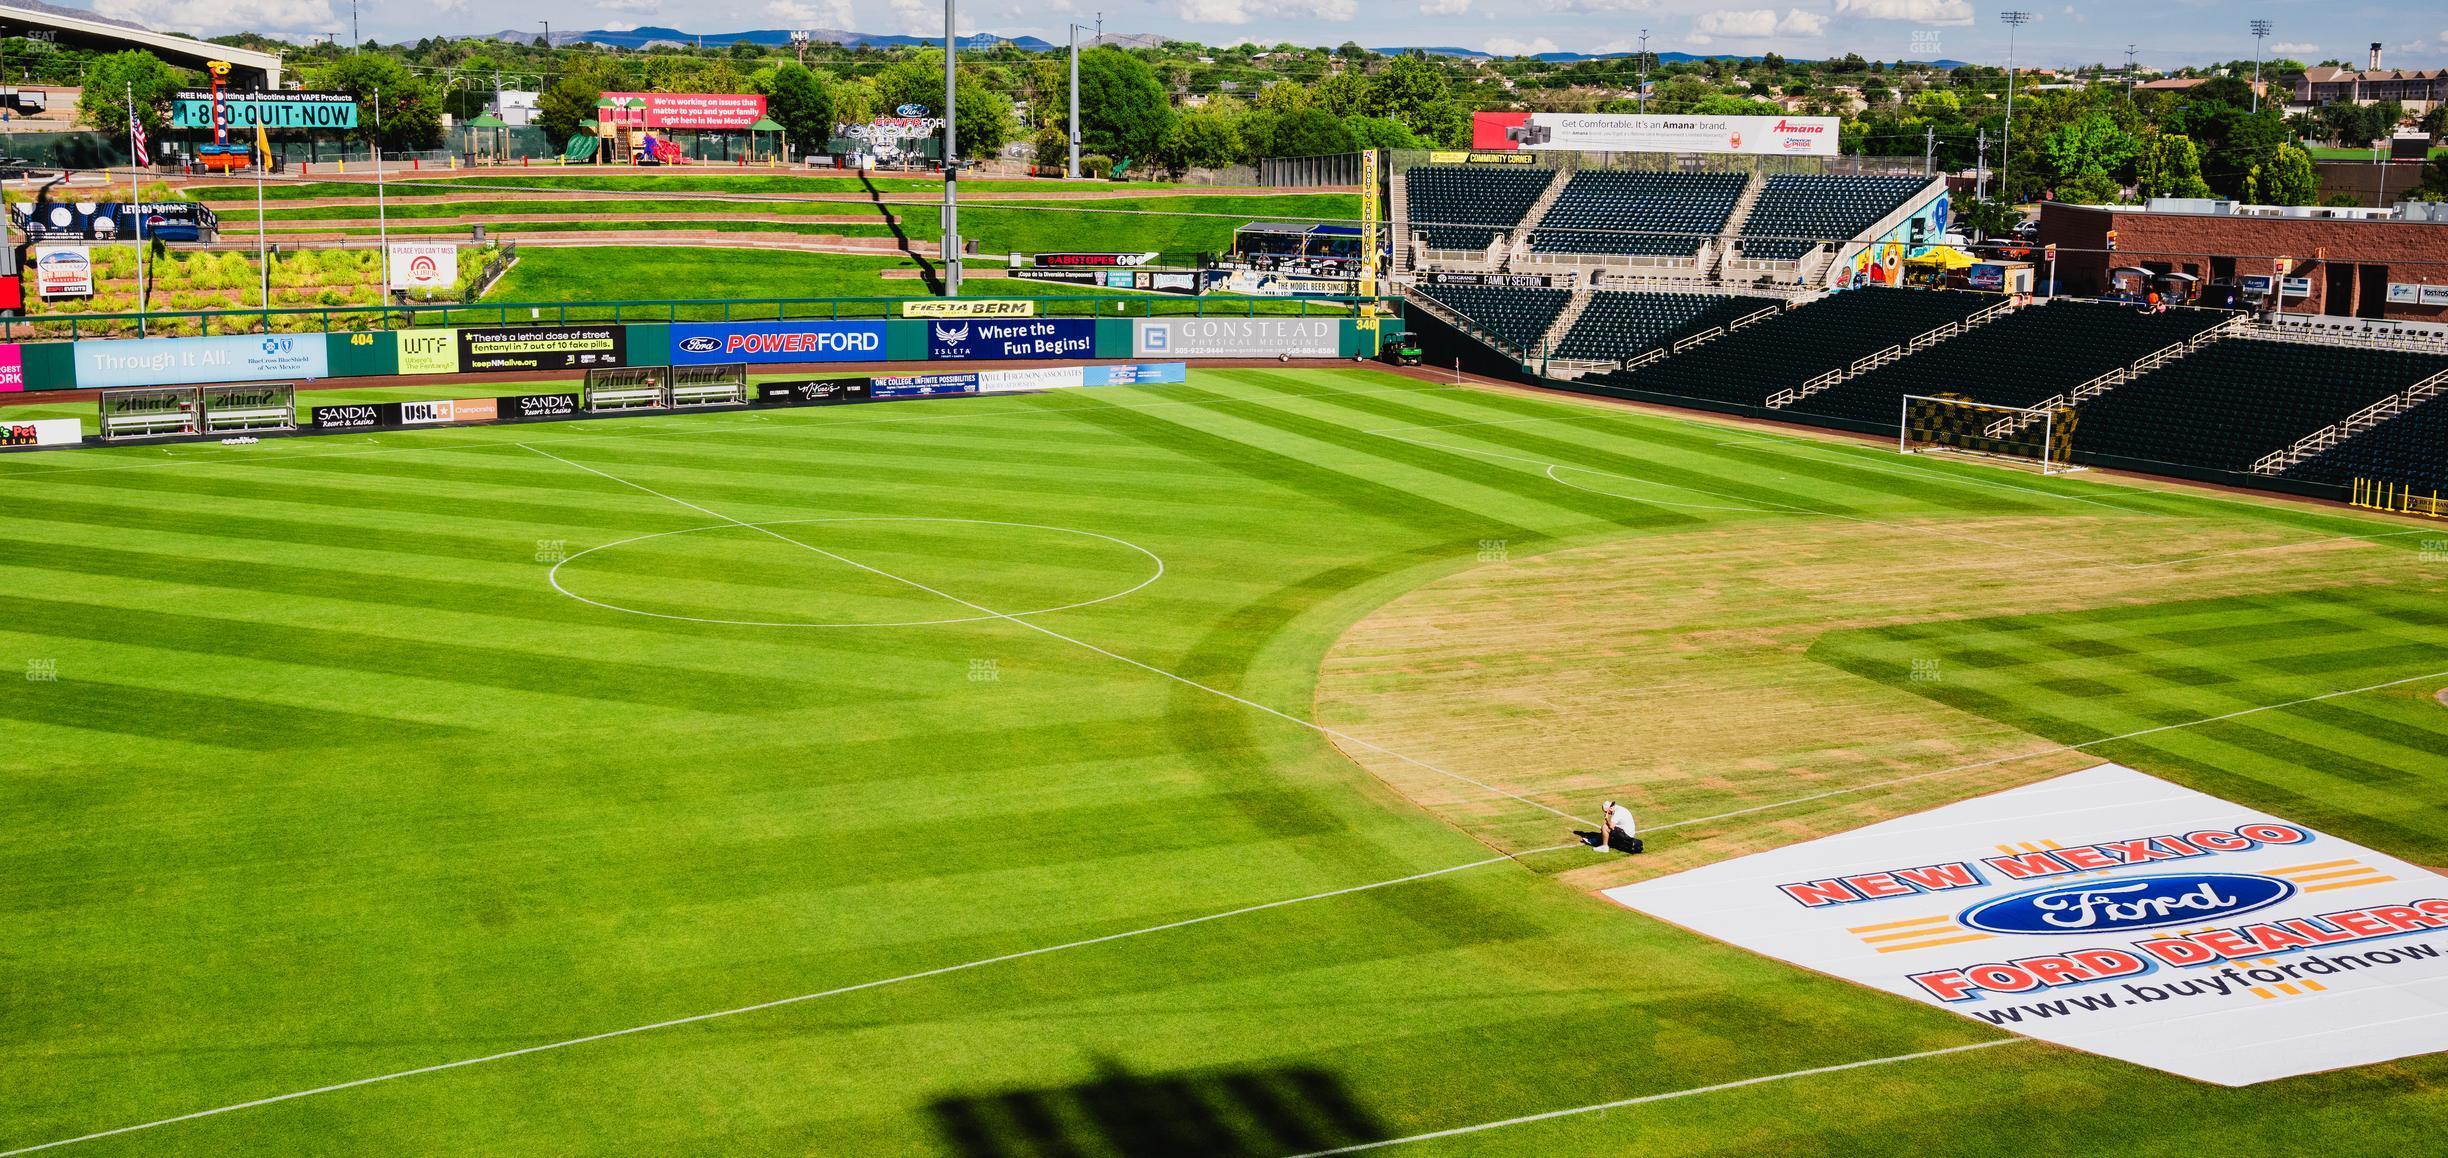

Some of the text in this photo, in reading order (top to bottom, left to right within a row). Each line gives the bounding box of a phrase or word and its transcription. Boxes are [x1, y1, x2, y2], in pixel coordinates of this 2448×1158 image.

[176, 91, 196, 99] FREE
[246, 92, 255, 100] all
[256, 93, 286, 101] Nicotine
[286, 93, 300, 101] and
[301, 94, 321, 102] VAPE
[321, 94, 353, 102] Products
[654, 97, 676, 105] We're
[676, 97, 707, 107] working
[719, 98, 741, 106] issues
[742, 98, 757, 106] that
[653, 107, 679, 115] matter
[688, 109, 702, 117] you
[718, 109, 736, 117] your
[736, 108, 759, 117] family
[661, 116, 683, 125] right
[684, 116, 698, 124] here
[706, 117, 723, 125] New
[723, 117, 751, 125] Mexico!
[1562, 119, 1577, 128] Get
[1579, 119, 1633, 129] Comfortable.
[1635, 120, 1648, 129] It's
[1663, 121, 1695, 130] Amana
[1699, 121, 1727, 130] brand.
[1773, 119, 1824, 134] Amana
[1469, 153, 1507, 163] COMMUNITY
[1508, 154, 1533, 164] CORNER
[141, 204, 152, 214] GO
[1278, 281, 1344, 292] THE MODEL BEER SINCE
[1483, 275, 1542, 287] FAMILY SECTION
[909, 303, 968, 311] FIESTA
[971, 303, 1027, 314] BERM
[1182, 321, 1328, 338] GONSTEAD
[1356, 319, 1376, 330] 340
[517, 332, 544, 341] lethal
[545, 332, 569, 340] dose
[571, 331, 581, 339] of
[582, 330, 610, 339] street
[978, 322, 1055, 340] Where the
[350, 334, 374, 346] 404
[405, 337, 447, 354] WTF
[474, 343, 512, 352] fentanyl
[513, 343, 522, 351] in
[569, 341, 589, 349] fake
[590, 340, 611, 349] pills.
[687, 332, 879, 354] Ford POWERFORD
[1004, 336, 1090, 355] Fun Begins!
[1191, 338, 1251, 346] PHYSICAL
[94, 352, 176, 371] Through
[183, 351, 195, 367] It
[472, 358, 538, 369] keepNMalive.org
[888, 378, 914, 386] COLLEGE,
[939, 374, 976, 383] POSSIBILITIES
[520, 395, 573, 411] SANDIA
[318, 406, 377, 421] SANDIA
[524, 408, 544, 416] Resort
[552, 407, 571, 415] Casino
[322, 420, 344, 428] Resort
[353, 418, 375, 426] Casino
[12, 424, 37, 438] Pet
[1776, 823, 2310, 908] NEW MEXICO
[2032, 882, 2238, 928] Ford
[1904, 948, 2150, 1003] FORD
